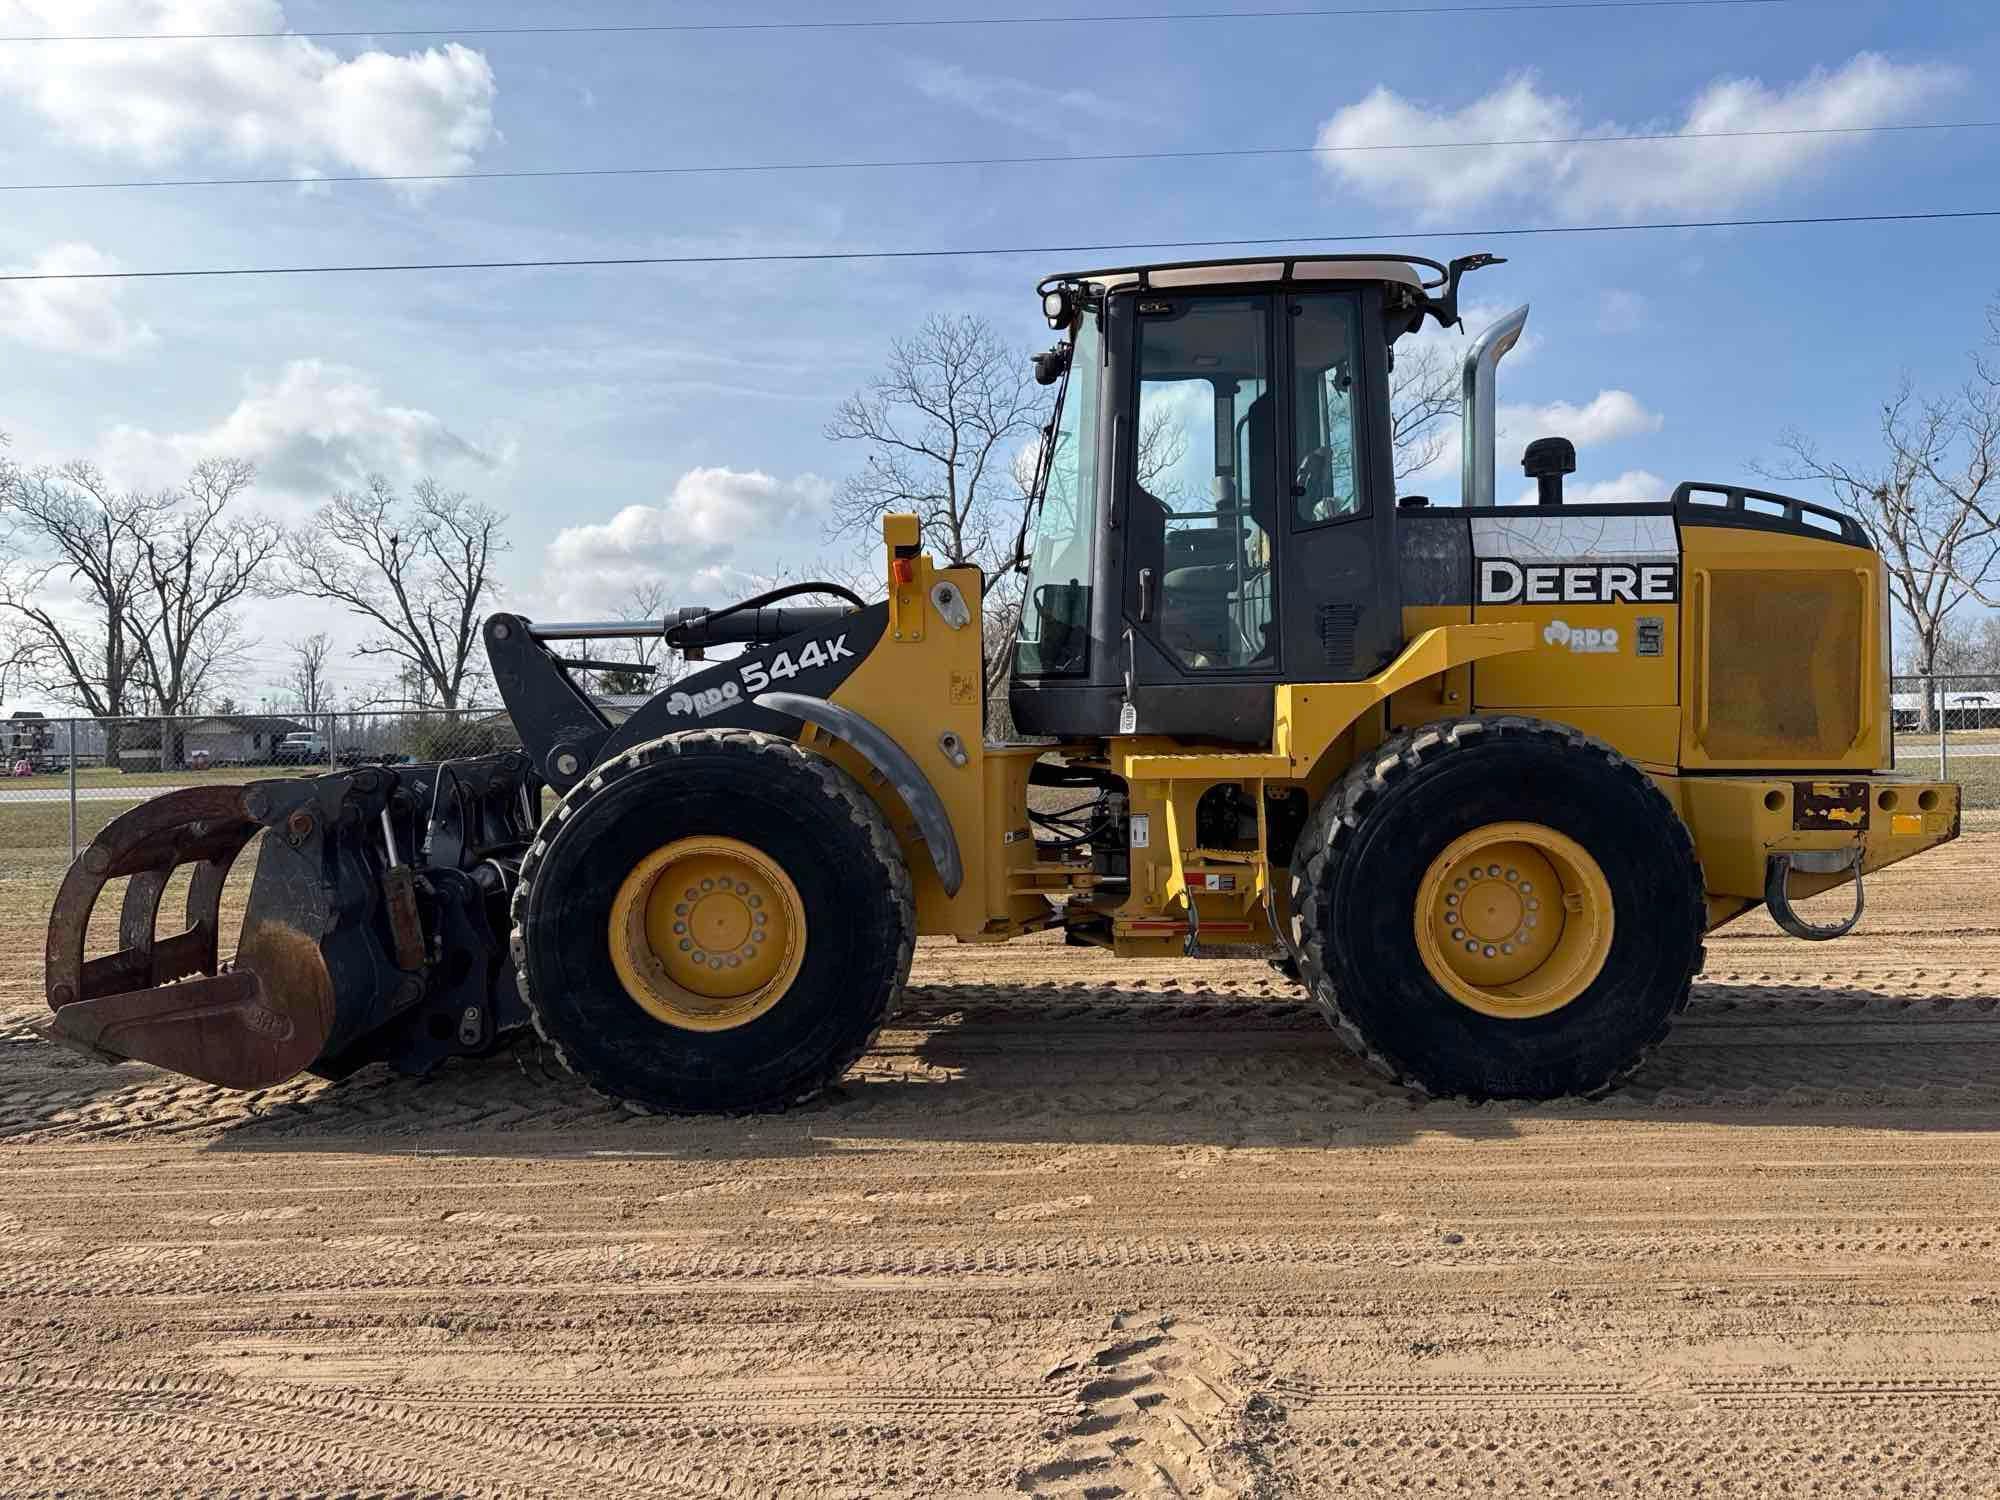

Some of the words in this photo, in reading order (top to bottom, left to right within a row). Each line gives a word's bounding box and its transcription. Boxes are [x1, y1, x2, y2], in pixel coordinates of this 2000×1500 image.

[1481, 561, 1674, 602] DEERE
[1571, 629, 1618, 648] RDO
[739, 633, 855, 692] 544K
